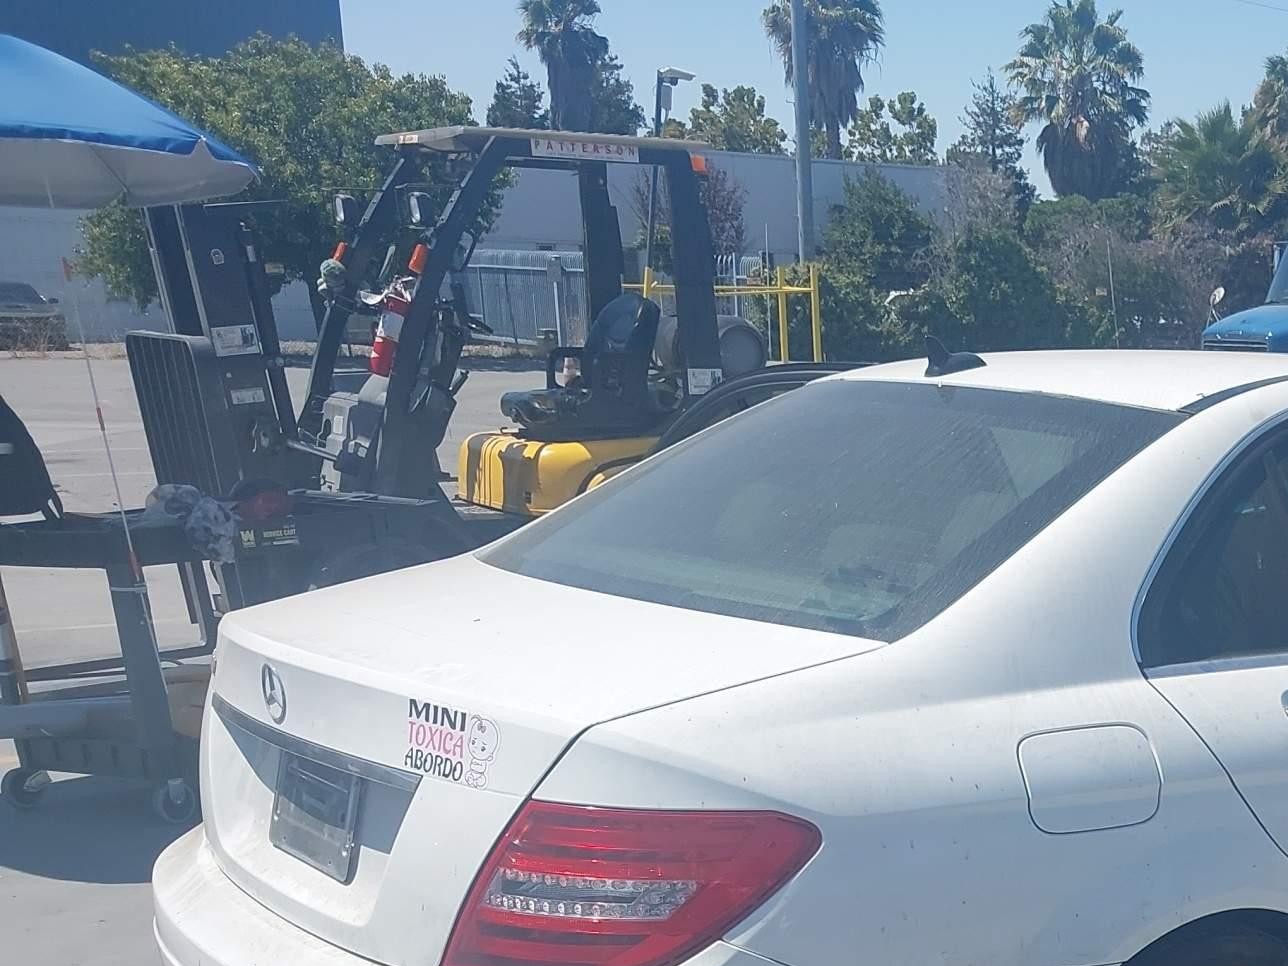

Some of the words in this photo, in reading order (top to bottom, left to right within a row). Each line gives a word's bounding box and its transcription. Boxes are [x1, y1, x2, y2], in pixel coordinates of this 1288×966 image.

[534, 140, 635, 156] PATTERSON
[408, 699, 466, 731] MINI
[408, 721, 463, 758] TOXICA
[404, 747, 463, 781] ABORDO
